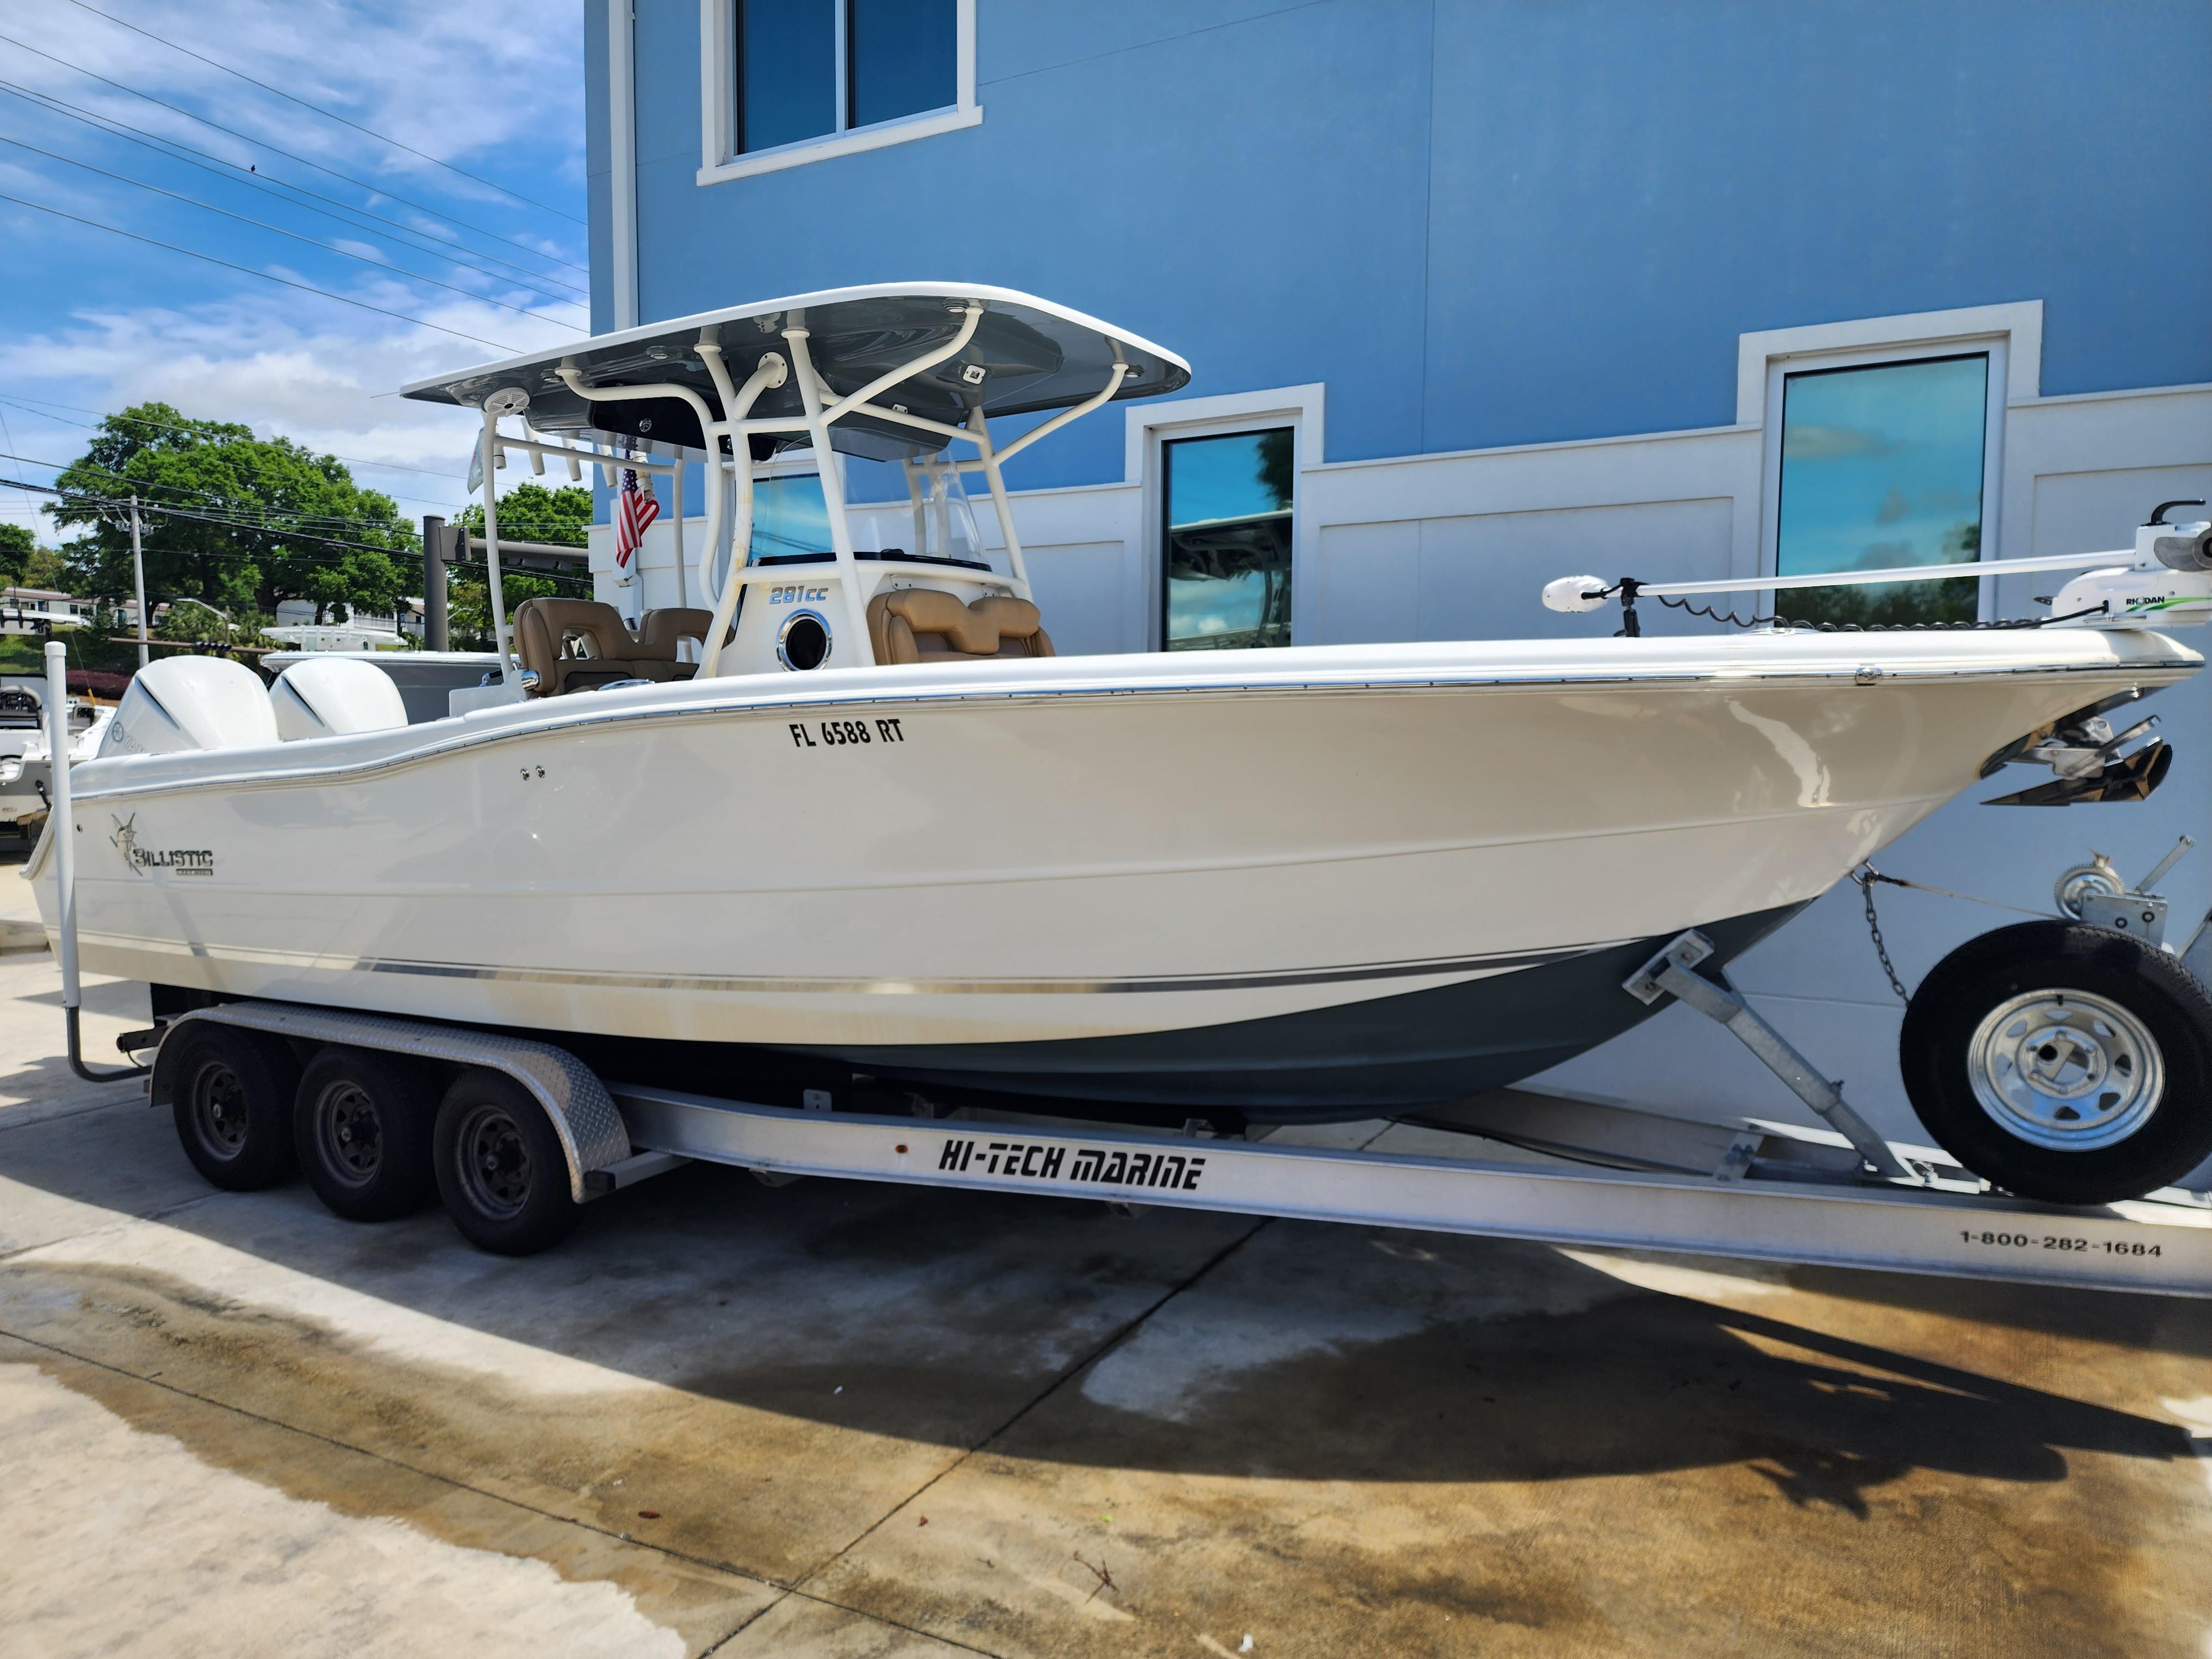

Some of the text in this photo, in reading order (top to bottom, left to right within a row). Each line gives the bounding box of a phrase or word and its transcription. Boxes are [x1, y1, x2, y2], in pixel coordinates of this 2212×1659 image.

[789, 719, 904, 747] FL 6588 RT
[939, 1140, 1206, 1190] HI-TECH MARINE
[1961, 1230, 2162, 1258] 1-800-282-1684
